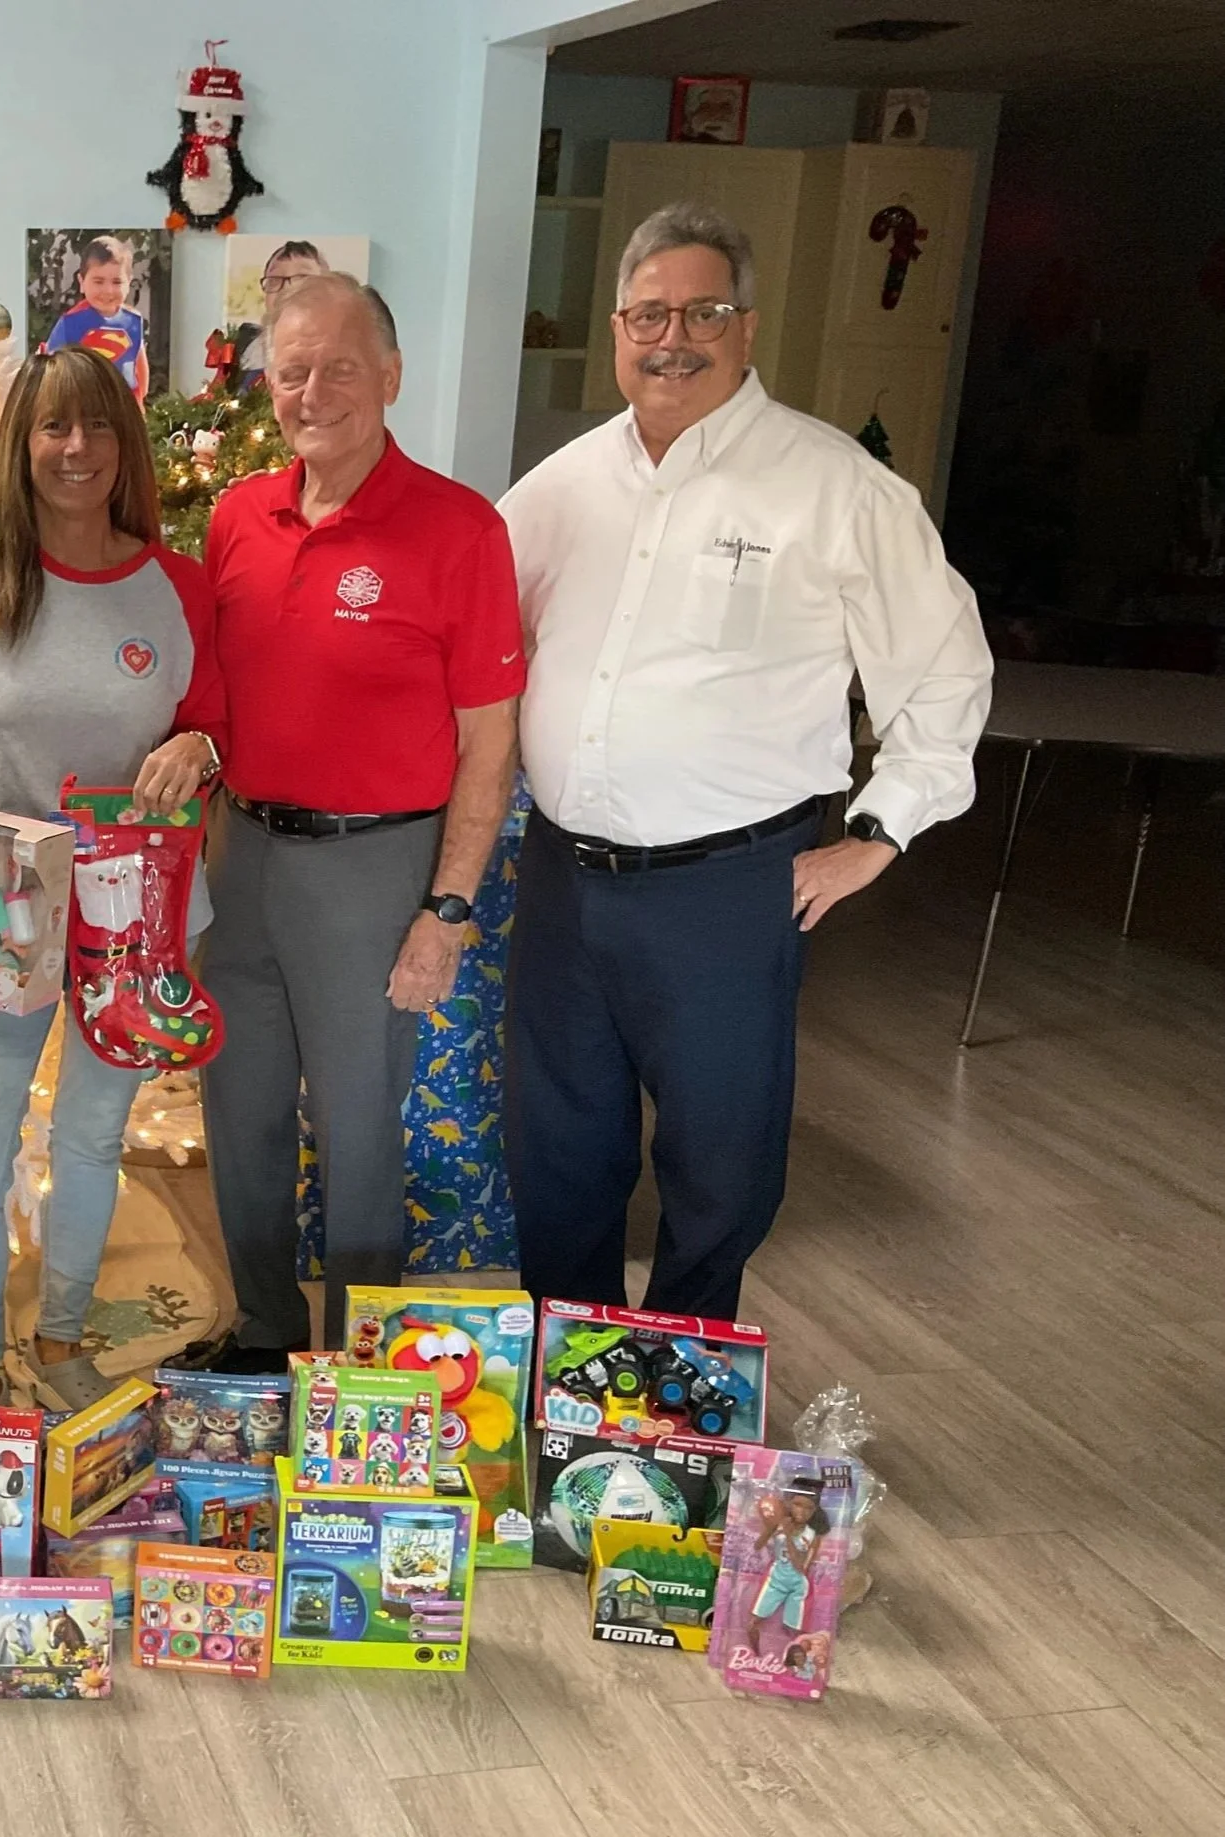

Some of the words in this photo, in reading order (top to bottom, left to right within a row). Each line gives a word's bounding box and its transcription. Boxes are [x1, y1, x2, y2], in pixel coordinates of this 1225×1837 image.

[746, 542, 771, 554] Jones
[334, 608, 370, 623] MAYOR
[547, 1398, 601, 1428] KID
[163, 1464, 179, 1472] 100
[181, 1466, 210, 1475] Pieces
[211, 1468, 241, 1477] Jigsaw
[292, 1523, 372, 1541] TERRARIUM
[646, 1580, 706, 1598] Tonka
[595, 1623, 675, 1647] Tonka
[302, 1651, 323, 1659] Kids
[728, 1645, 788, 1674] Barbie
